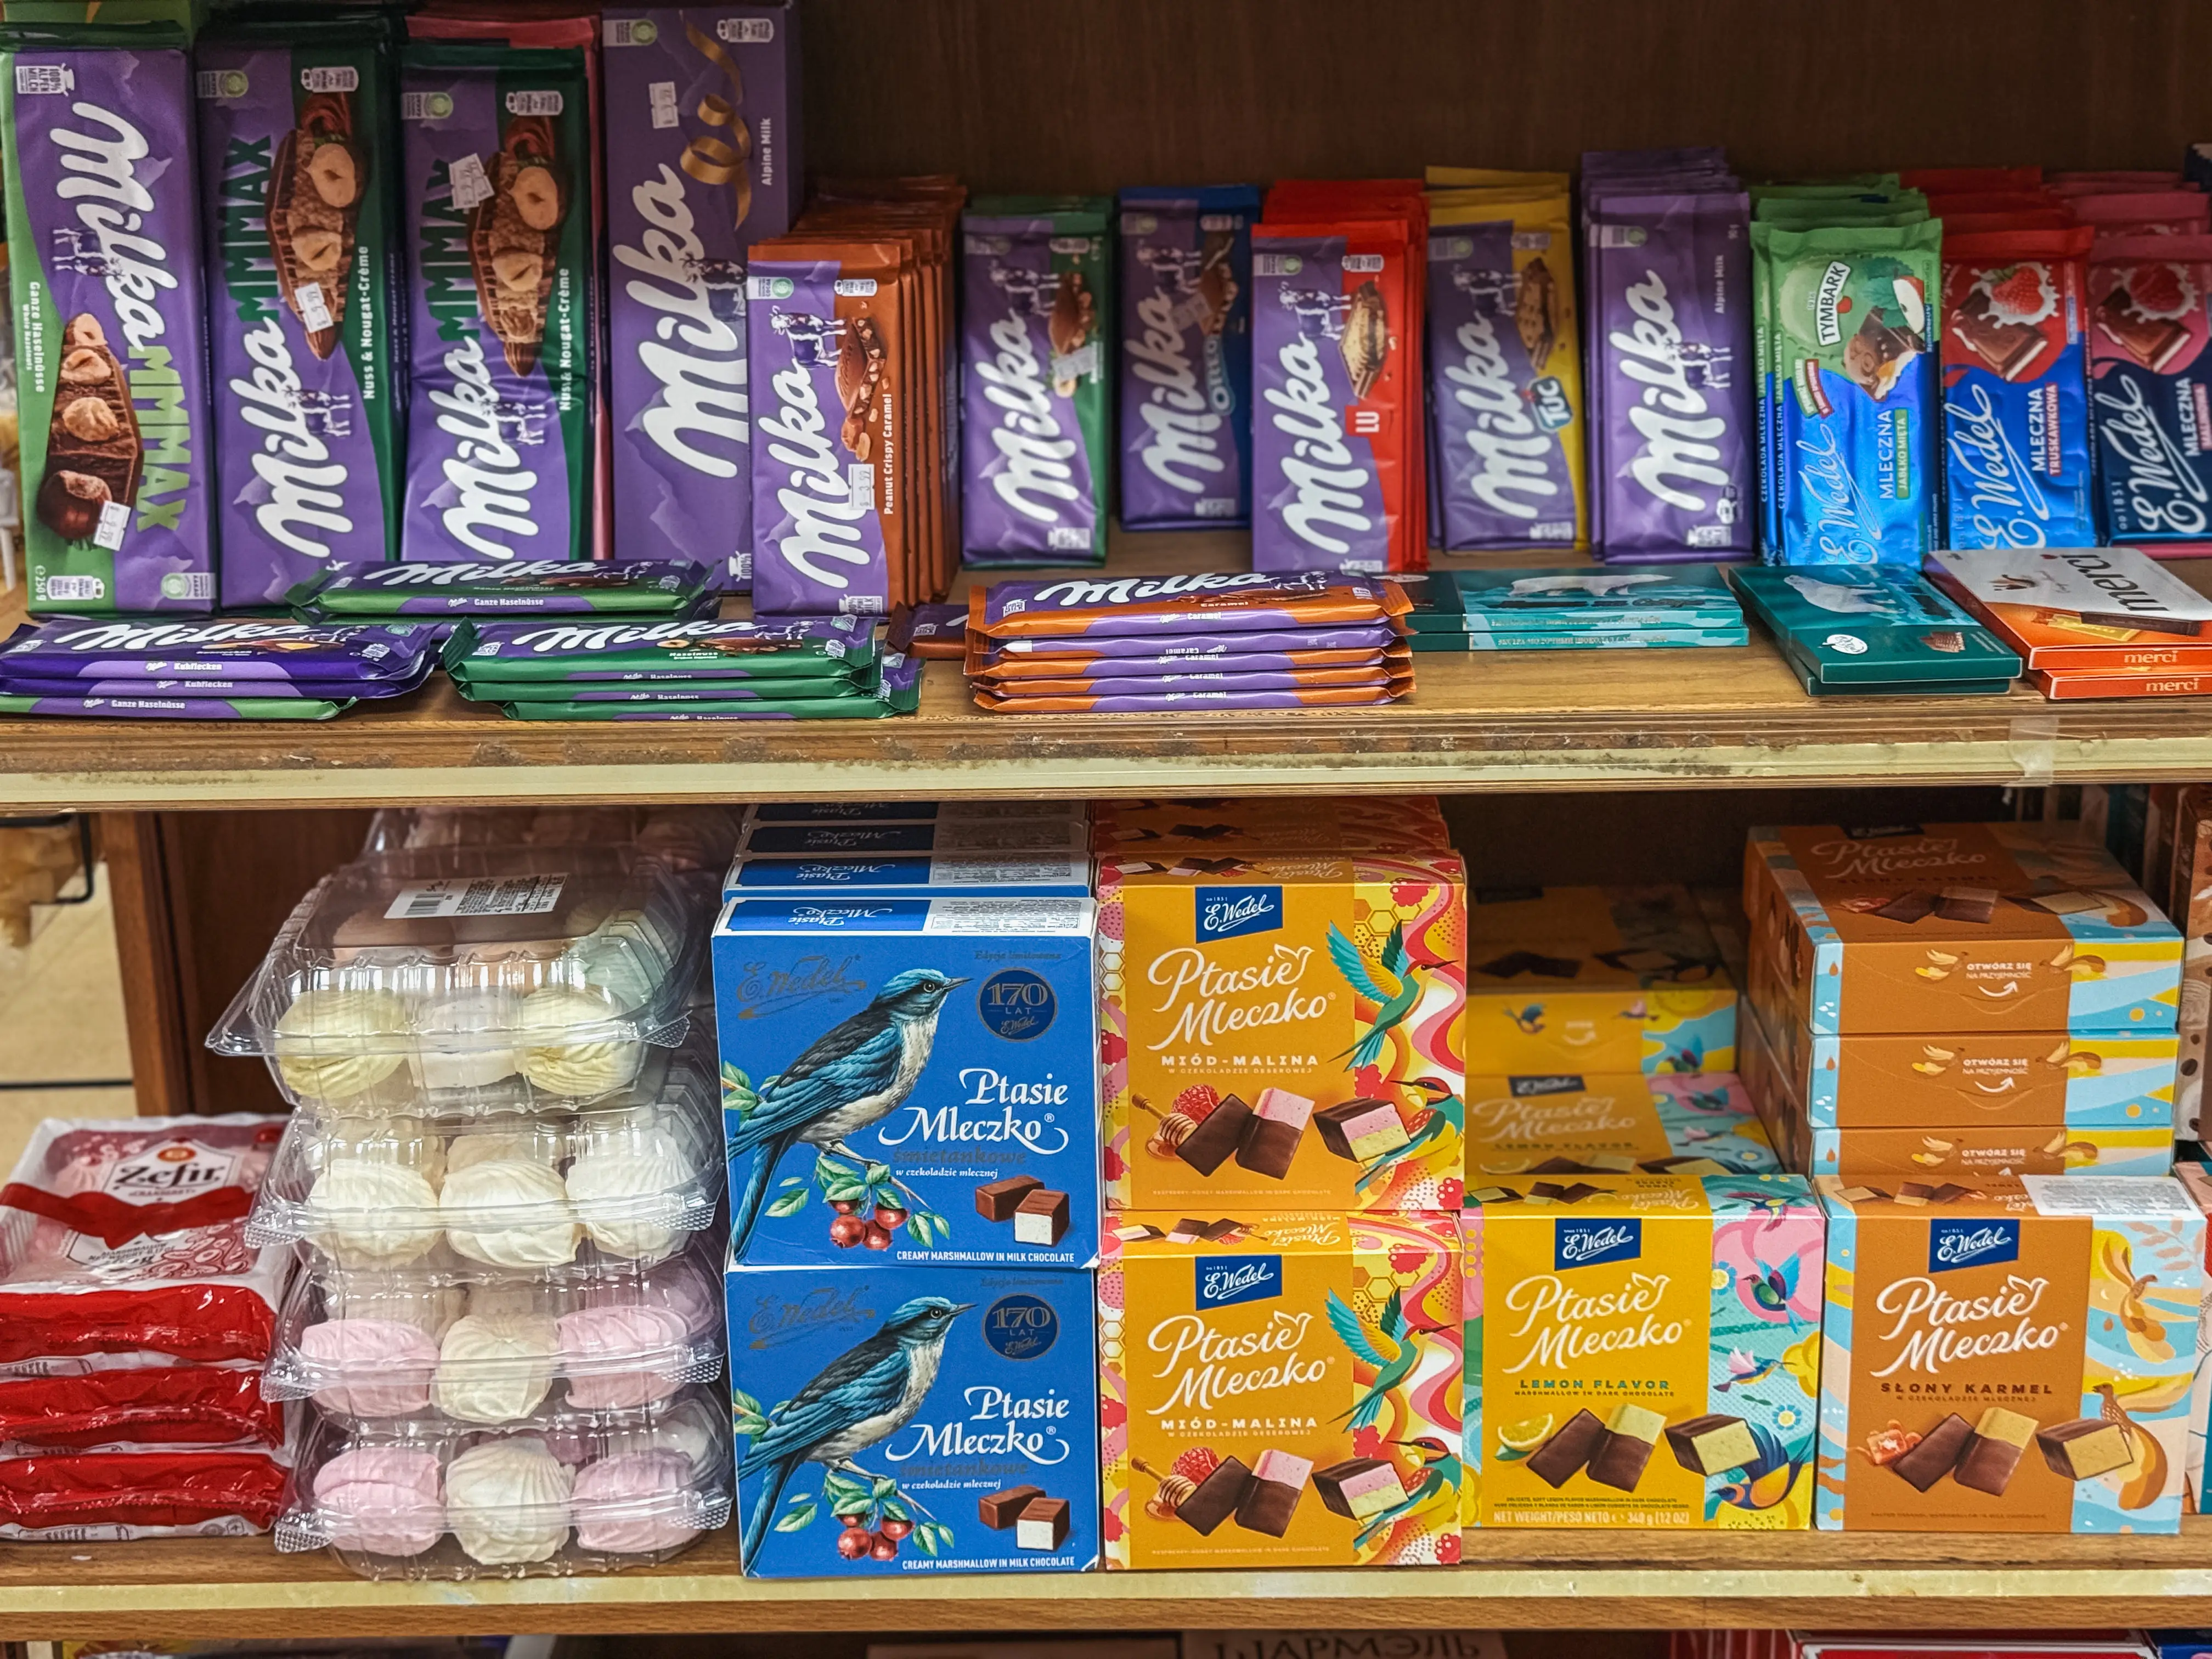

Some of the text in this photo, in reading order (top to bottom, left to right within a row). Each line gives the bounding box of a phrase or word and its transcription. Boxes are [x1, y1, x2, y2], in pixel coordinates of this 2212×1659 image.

[28, 67, 40, 93] MILCH
[38, 67, 50, 93] ALPEN
[49, 68, 61, 92] 100%
[760, 116, 774, 186] Alpine Milk
[50, 103, 178, 352] Milka
[218, 136, 278, 321] MMMAX
[1714, 255, 1726, 314] Alpine Milk
[557, 268, 572, 368] Nougat-Crème
[1820, 264, 1847, 342] TYMBARK
[29, 281, 47, 392] Ganze Haselnüsse
[356, 246, 376, 399] Nuss & Nougat-Crème
[612, 164, 748, 478] Milka
[1124, 286, 1225, 493] Milka
[1538, 381, 1568, 425] TUC
[1609, 270, 1729, 511] Milka
[974, 308, 1080, 522] Milka
[1356, 411, 1380, 433] LU
[1444, 311, 1558, 518] Milka
[1758, 398, 1767, 444] MLECZNA
[2027, 388, 2045, 471] MLECZNA
[2046, 384, 2059, 475] TRUSKAWKOWA
[2175, 377, 2200, 456] MLECZNA
[129, 347, 194, 531] MMMAX
[229, 316, 354, 557] Milka
[428, 335, 540, 560] Milka
[1262, 332, 1372, 554] Milka
[1896, 418, 1907, 490] JABŁKO MIĘTA
[882, 394, 894, 515] Peanut Crispy Caramel
[1775, 405, 1786, 510] CZEKOLADA MLECZNA
[1877, 410, 1894, 499] MLECZNA
[758, 358, 870, 589] Milka
[1759, 445, 1768, 502] CZEKOLADA
[363, 561, 608, 586] Milka
[1034, 572, 1284, 606] Milka
[2067, 552, 2170, 613] merci
[474, 597, 544, 607] Ganze Haselnüsse
[1187, 612, 1222, 621] Caramel
[54, 623, 321, 651] Milka
[511, 619, 766, 653] Milka
[173, 662, 223, 672] Kuhflecken
[2124, 650, 2179, 665] merci
[185, 680, 233, 689] Kuhflecken
[1192, 691, 1227, 699] Caramel
[2146, 677, 2199, 692] merci
[111, 699, 186, 709] Ganze Haselnüsse
[1810, 838, 1959, 865] Ptasie
[1826, 851, 1987, 878] Mleczko
[795, 871, 851, 881] Ptasie
[788, 915, 845, 927] Ptasie
[793, 906, 893, 918] Mleczko
[1147, 944, 1315, 1013] Ptasie
[1966, 962, 2013, 971] OTWÓRZ
[988, 982, 1047, 1007] 170
[1146, 989, 1327, 1051] Mleczko
[1963, 1058, 2010, 1068] OTWÓRZ
[958, 1068, 1069, 1107] Ptasie
[1473, 1098, 1616, 1127] Ptasie
[1479, 1115, 1636, 1143] Mleczko
[1961, 1158, 1971, 1166] NA
[1962, 1149, 2007, 1158] OTWÓRZ
[115, 1162, 225, 1189] Zefir
[896, 1167, 998, 1180] w czekoladzie mlecznej
[896, 1250, 1075, 1262] CREAMY MARSHMALLOW IN MILK CHOCOLATE
[992, 1306, 1051, 1329] 170
[1505, 1272, 1672, 1337] Ptasie
[1876, 1274, 2050, 1341] Ptasie
[1009, 1328, 1035, 1336] LAT
[1147, 1310, 1314, 1378] Ptasie
[1502, 1313, 1683, 1374] Mleczko
[1869, 1317, 2059, 1378] Mleczko
[1146, 1352, 1327, 1416] Mleczko
[1520, 1379, 1670, 1389] LEMON FLAVOR
[1881, 1383, 2053, 1395] SŁONY KARMEL
[963, 1386, 1070, 1421] Ptasie
[902, 1479, 1001, 1491] w czekoladzie mlecznej
[1494, 1512, 1689, 1525] NET WEIGHT/PESO NETO 340 (12 OZ)
[902, 1556, 1075, 1570] CREAMY MARSHMALLOW IN MILK CHOCOLATE
